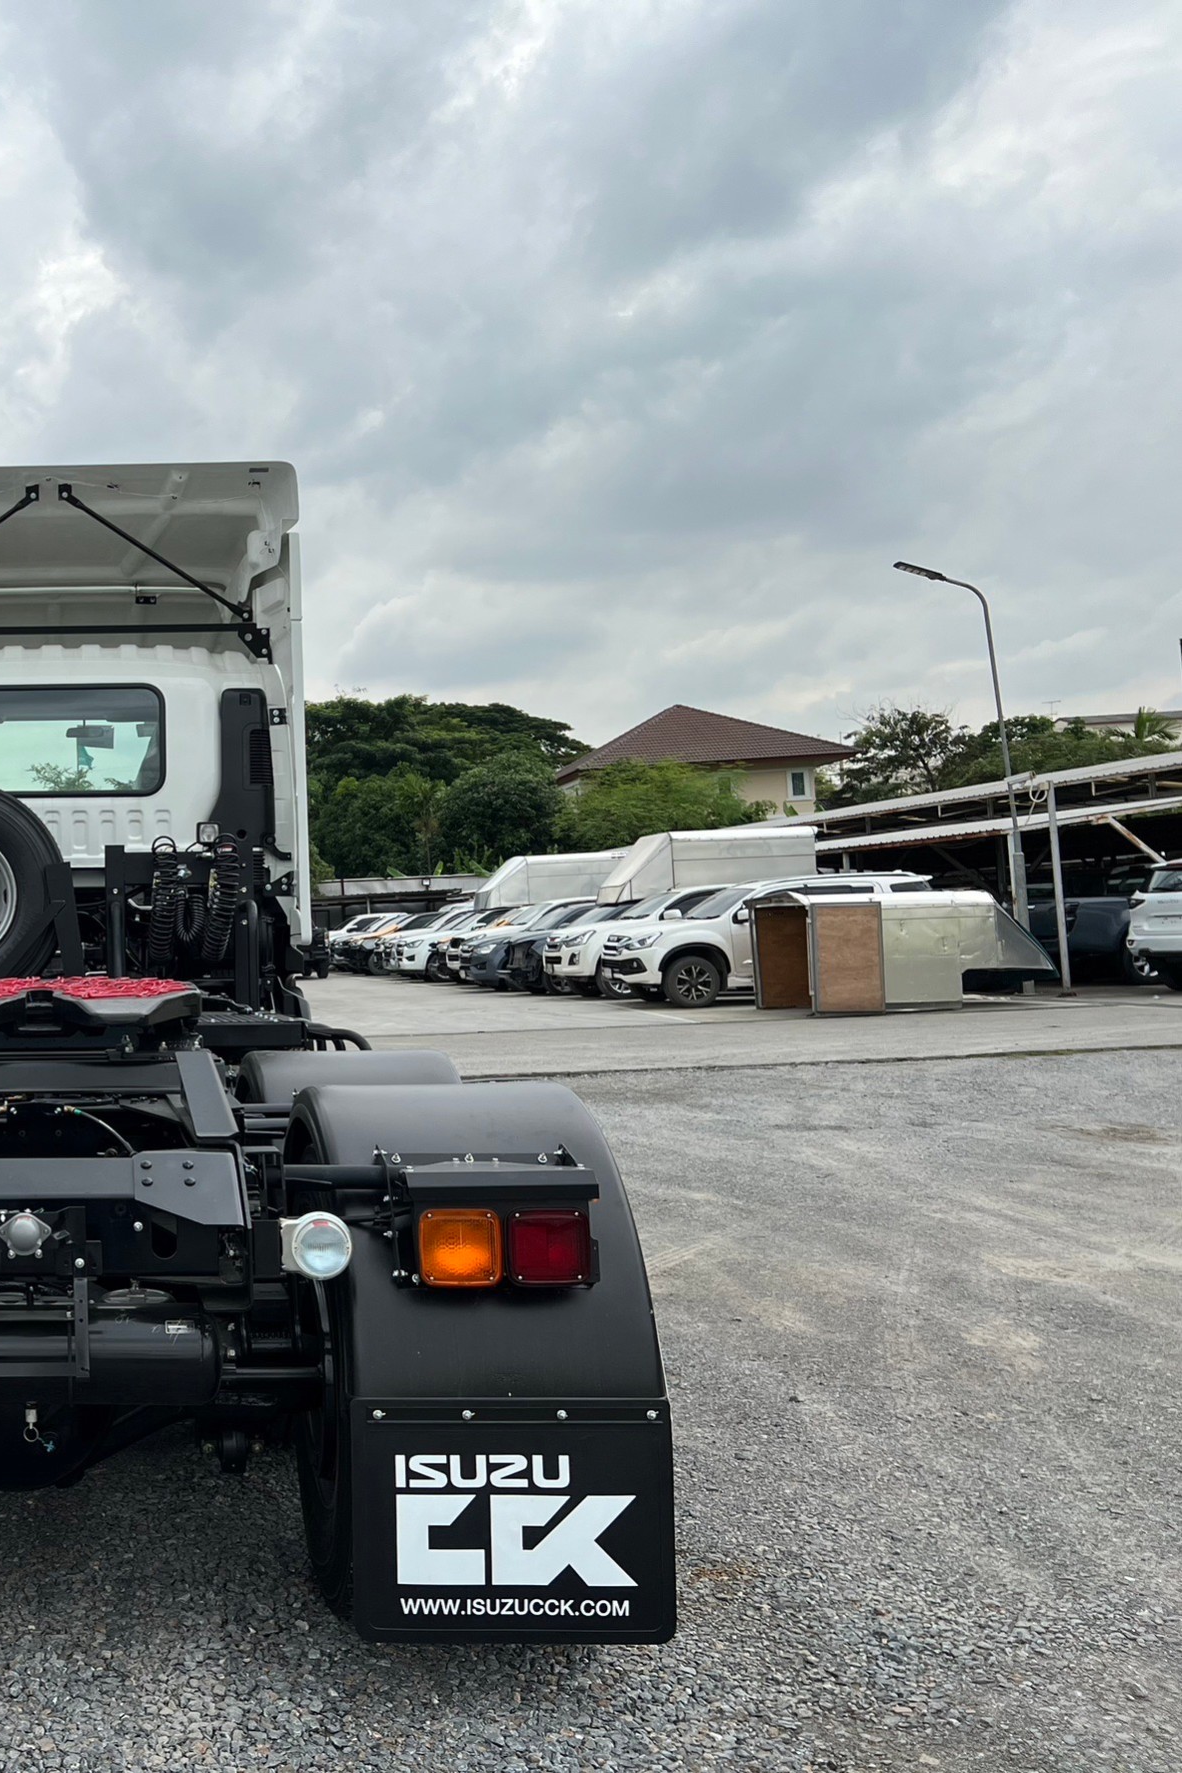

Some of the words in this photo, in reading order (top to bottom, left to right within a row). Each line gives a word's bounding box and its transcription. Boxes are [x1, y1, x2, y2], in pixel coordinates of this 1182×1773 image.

[394, 1454, 571, 1489] ISUZU
[395, 1493, 639, 1587] CCK
[399, 1597, 630, 1617] WWW.ISUZUCCK.COM
